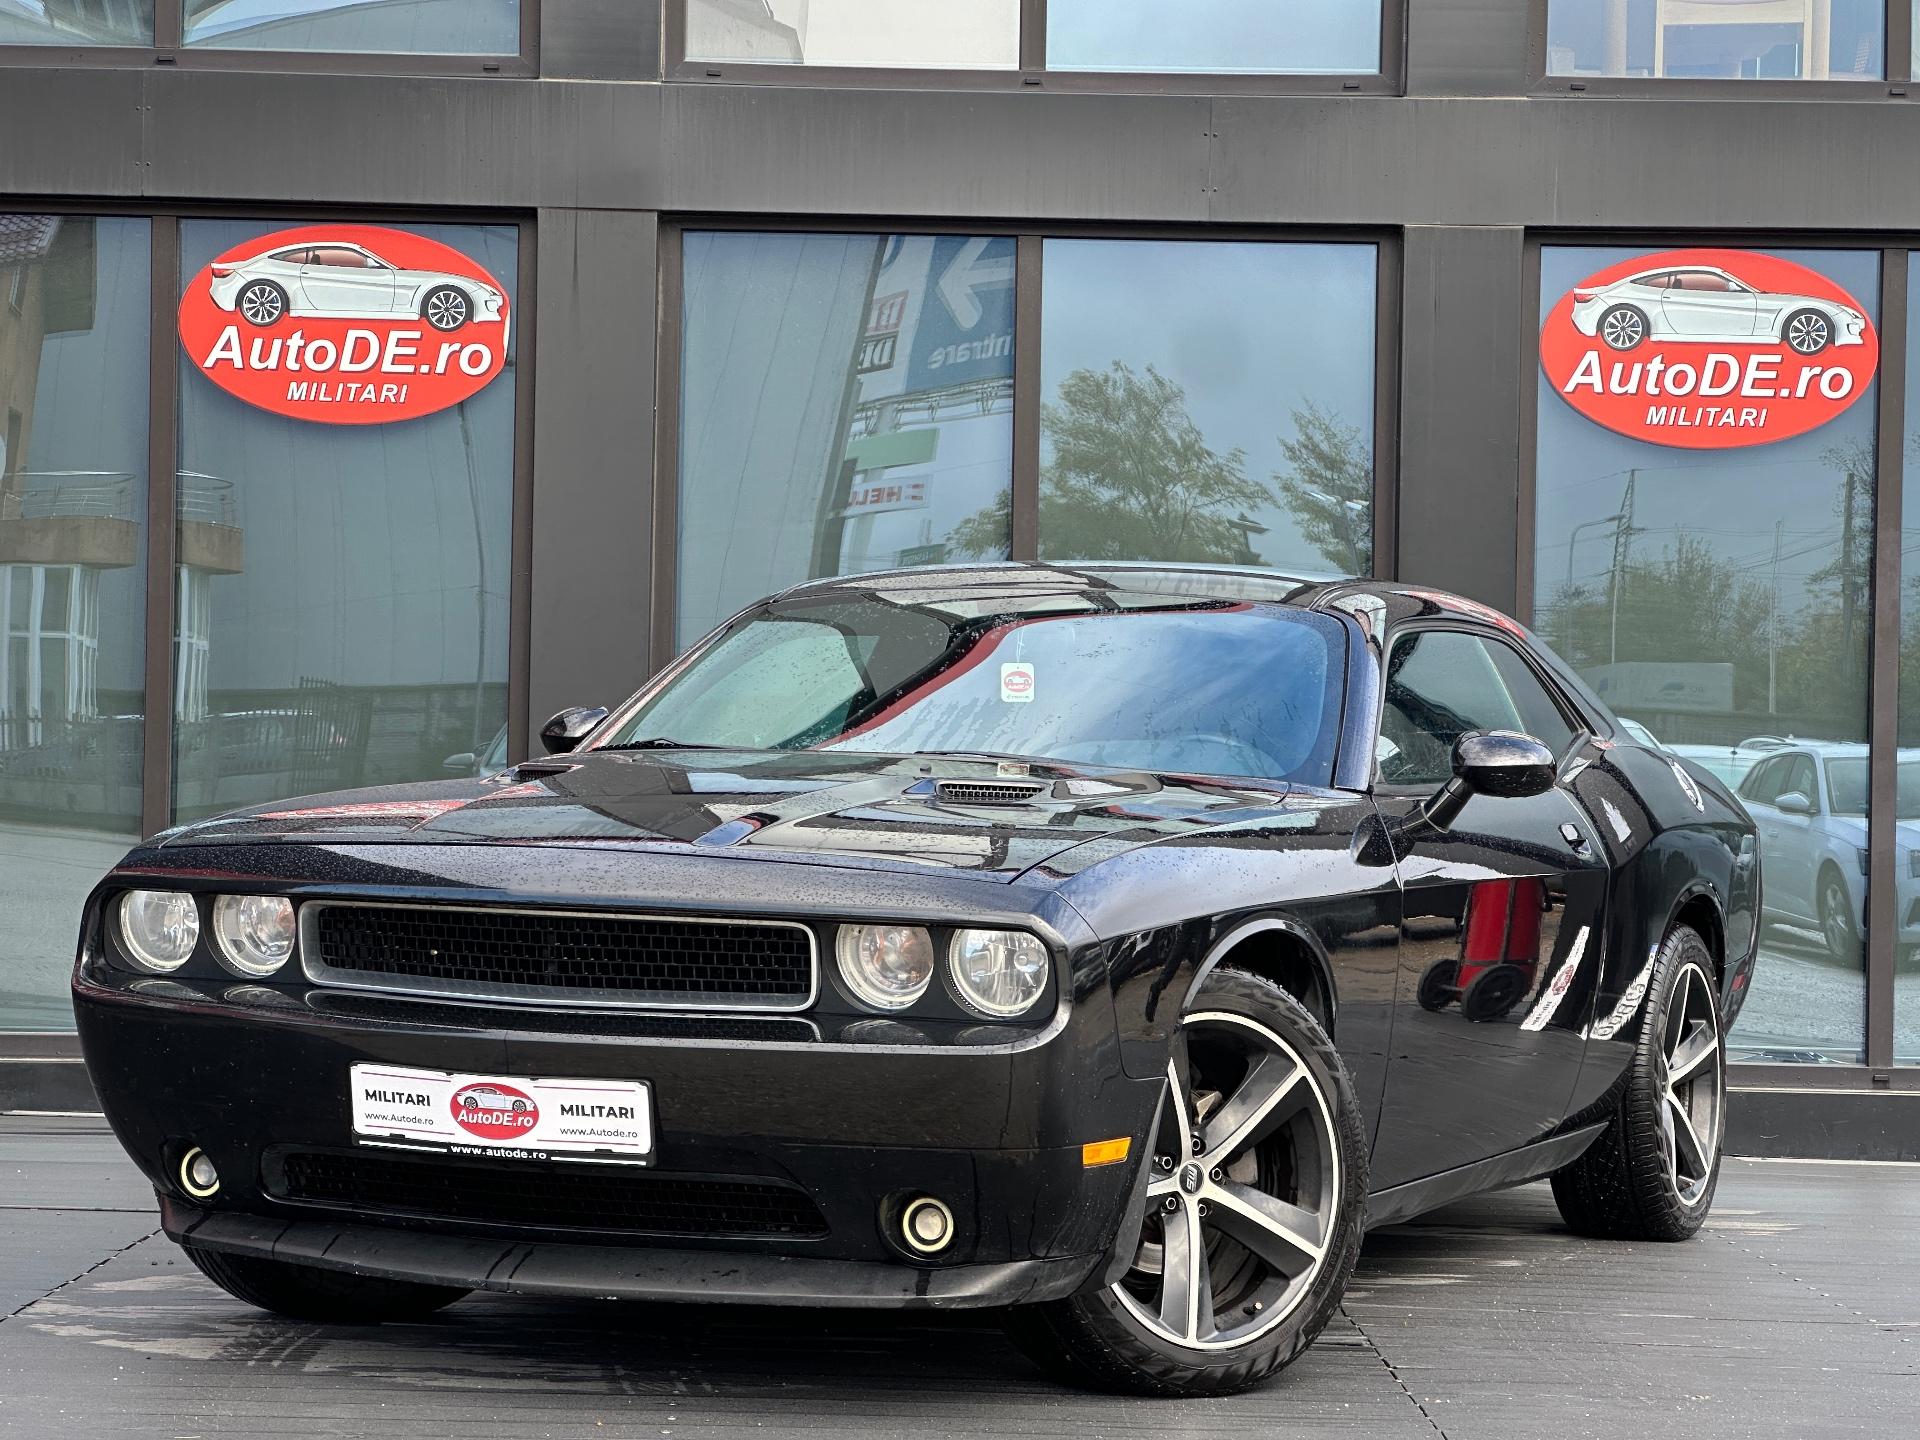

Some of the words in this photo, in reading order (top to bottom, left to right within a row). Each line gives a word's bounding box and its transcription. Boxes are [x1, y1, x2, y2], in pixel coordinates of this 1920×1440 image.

[202, 325, 493, 376] AutoDE.ro
[1563, 350, 1854, 400] AutoDE.ro
[286, 381, 409, 403] MILITARI
[1645, 406, 1768, 428] MILITARI
[364, 1088, 431, 1107] MILITARI
[364, 1112, 434, 1126] www.Autode.ro
[457, 1109, 534, 1128] AutoDE.ro
[560, 1103, 635, 1119] MILITARI
[559, 1127, 638, 1139] www.Autode.ro
[450, 1145, 547, 1160] www.autode.ro
